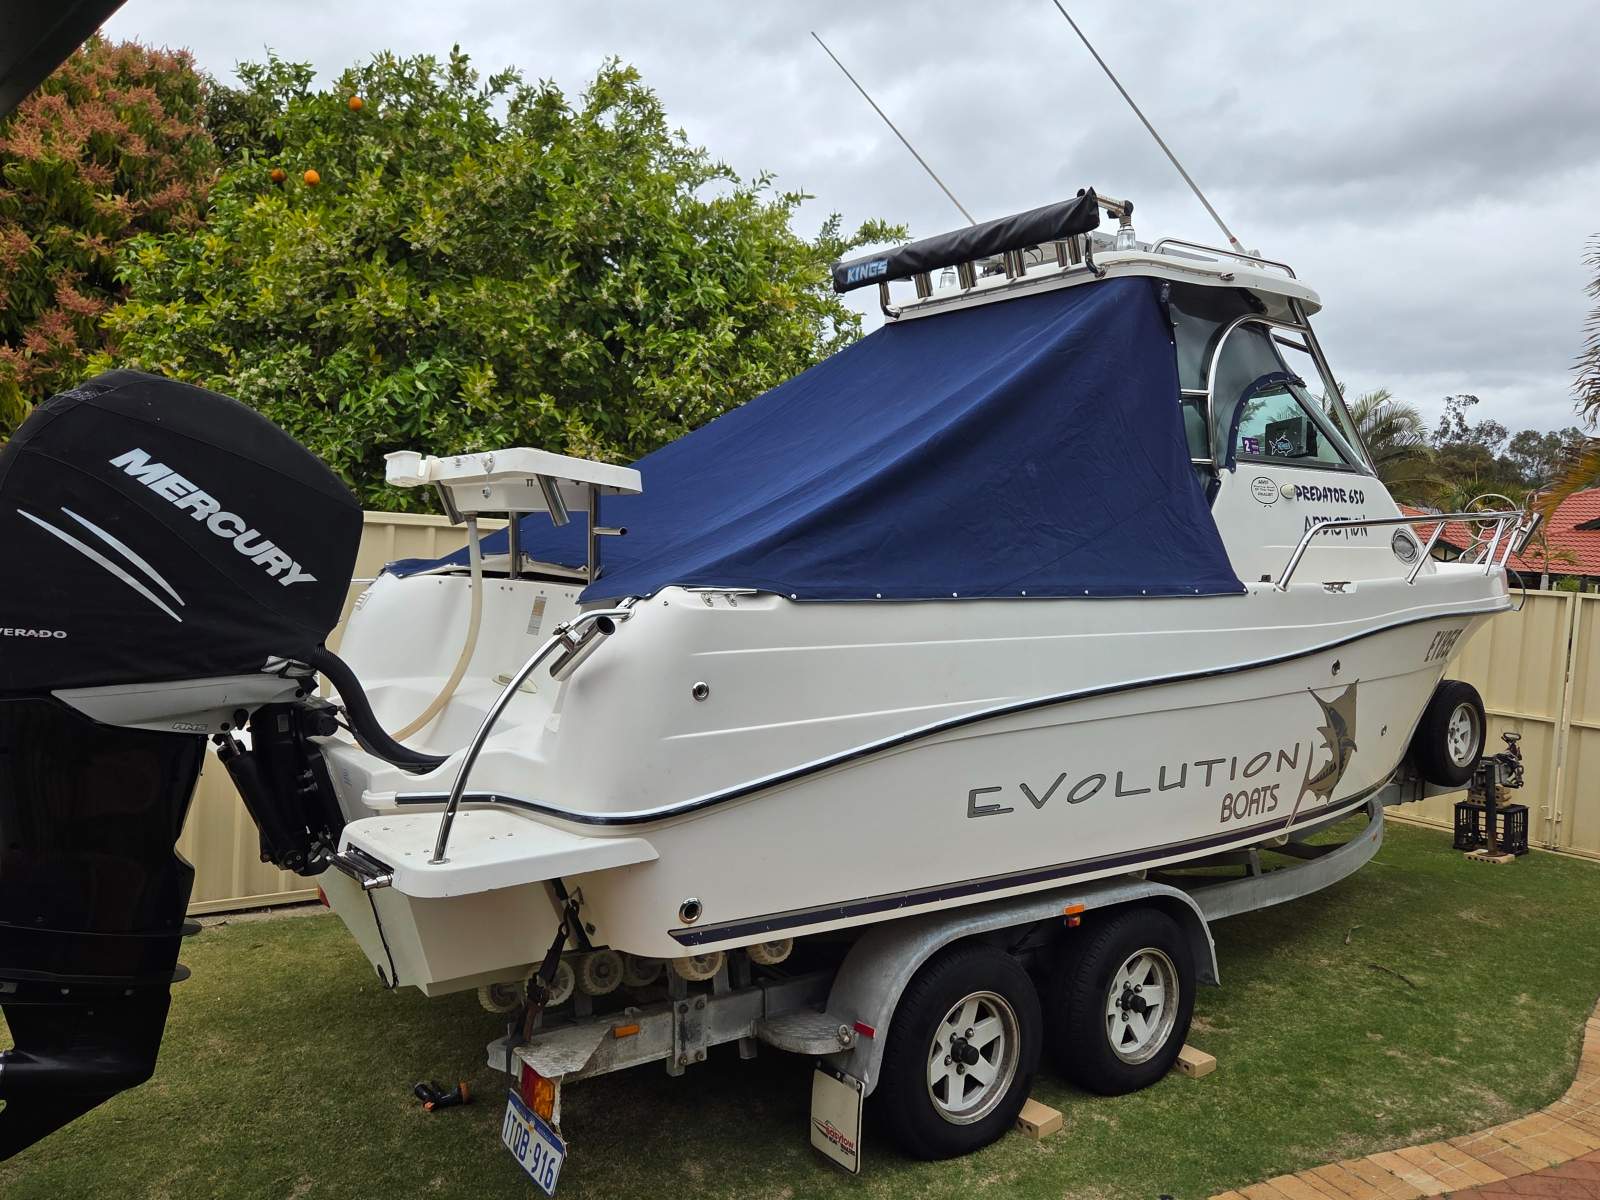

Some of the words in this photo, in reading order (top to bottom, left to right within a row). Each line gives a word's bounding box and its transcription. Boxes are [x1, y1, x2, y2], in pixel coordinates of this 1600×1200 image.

[847, 260, 888, 284] KINGS
[1295, 485, 1347, 503] PREDATOR
[1349, 489, 1364, 504] 650
[108, 447, 317, 587] MERCURY
[0, 628, 67, 639] ERADO
[967, 742, 1300, 819] EVOLUTION
[1220, 784, 1280, 823] BOATS
